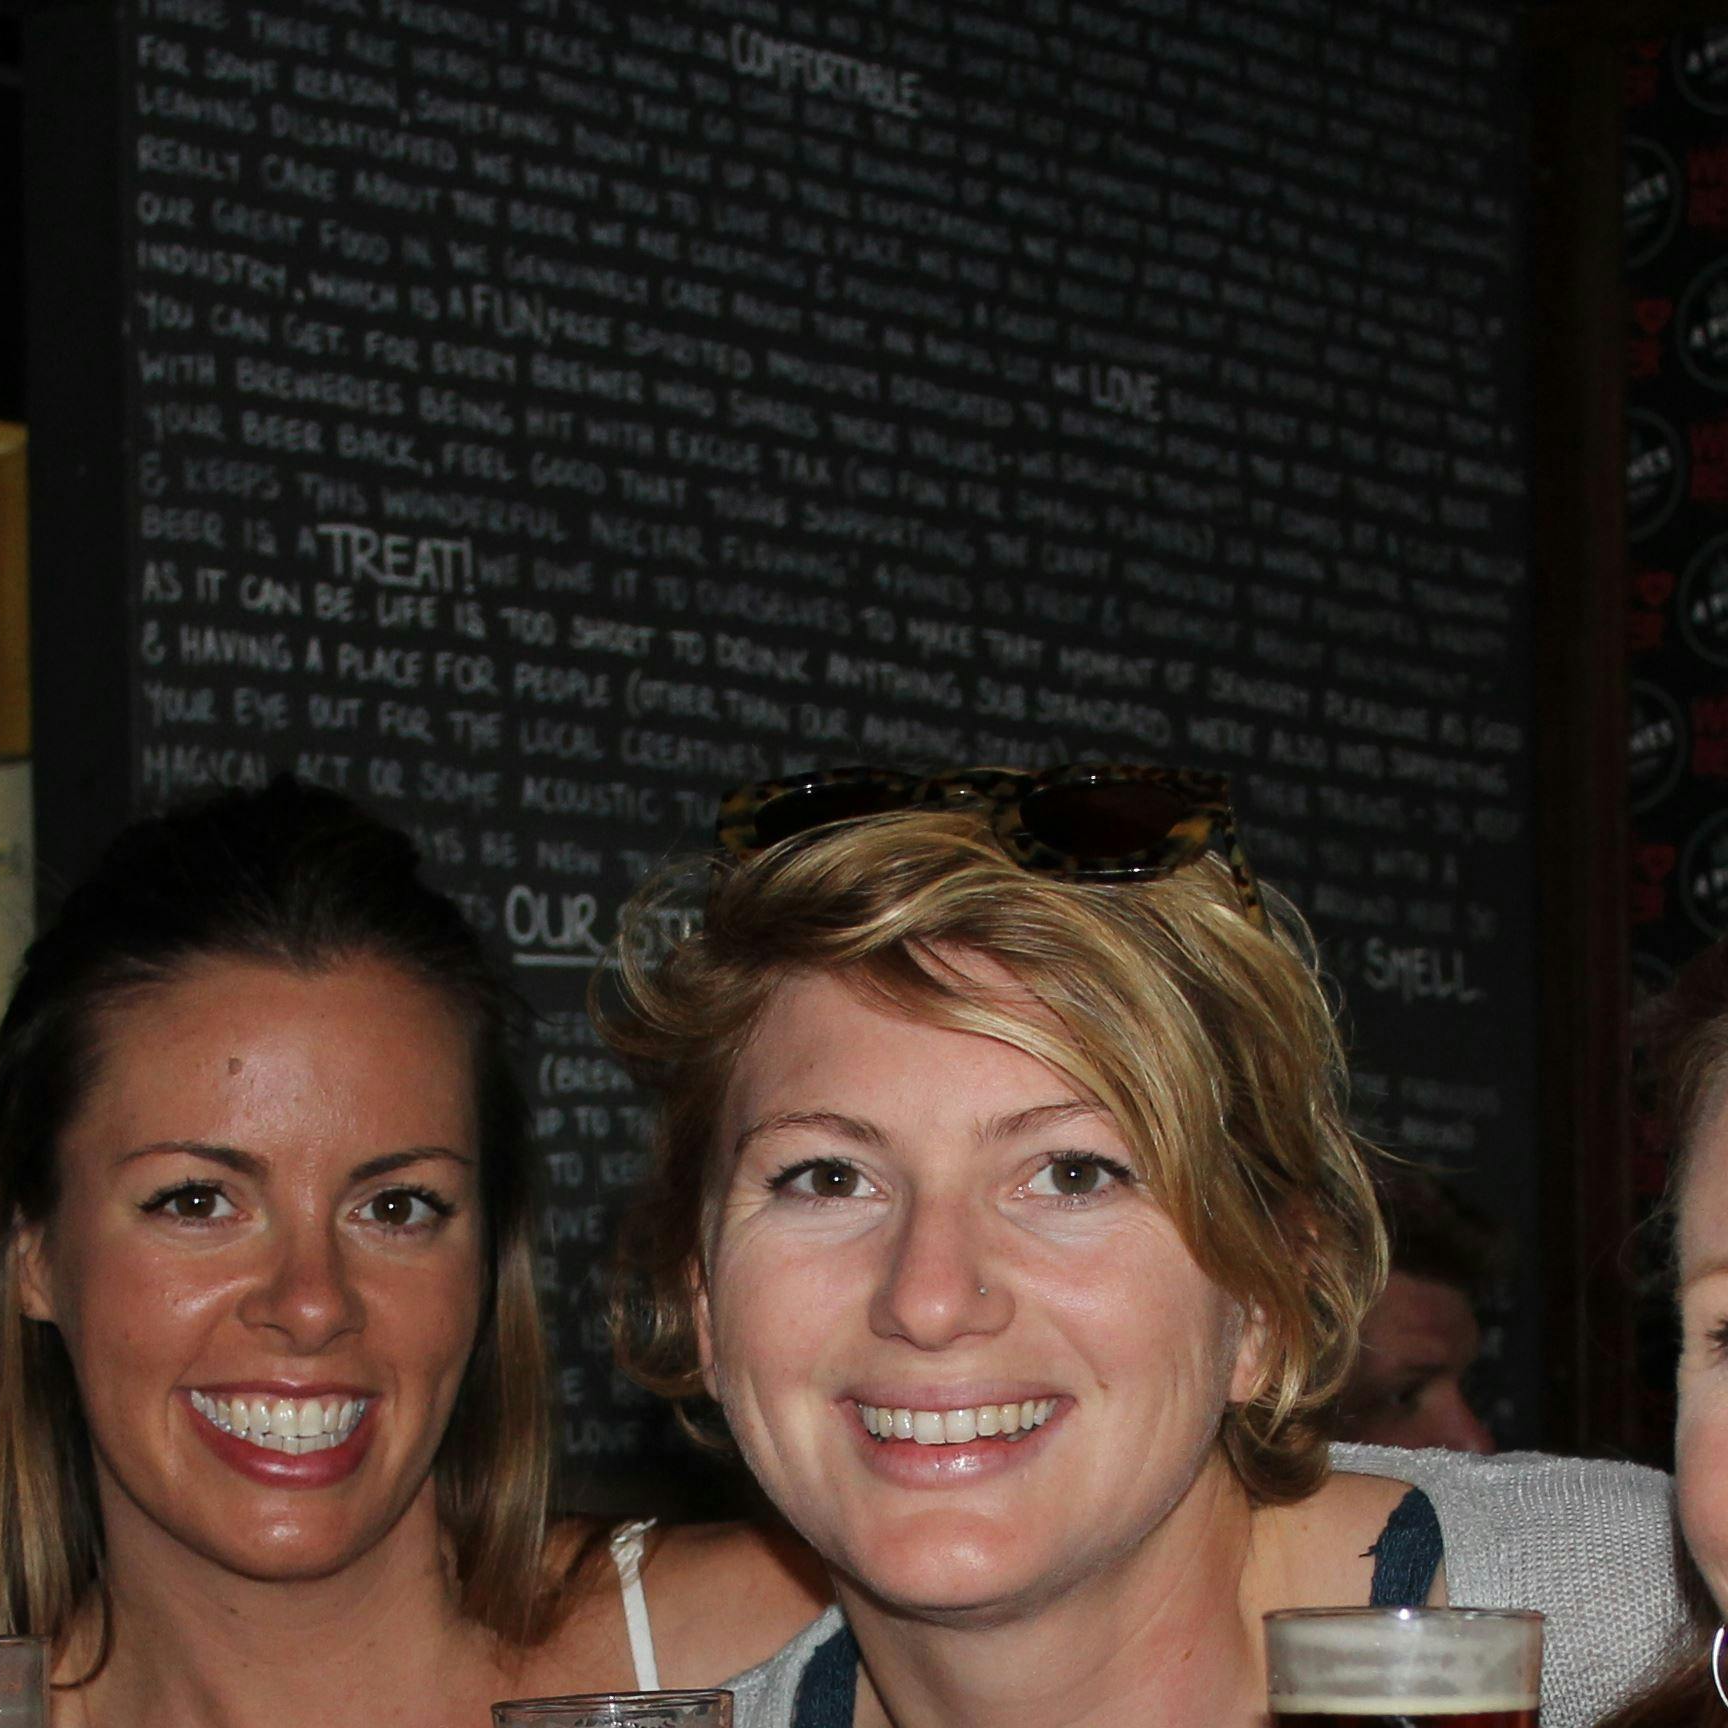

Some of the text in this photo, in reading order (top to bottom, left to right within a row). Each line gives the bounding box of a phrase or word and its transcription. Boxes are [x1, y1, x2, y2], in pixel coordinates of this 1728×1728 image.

[135, 190, 195, 228] OUR
[211, 304, 270, 343] CAN
[136, 348, 217, 386] WITH
[1087, 362, 1164, 423] LOVE
[241, 410, 323, 453] BEER
[315, 521, 476, 595] TREAT!
[141, 559, 184, 604] AS
[195, 567, 228, 603] IT
[239, 574, 303, 615] CAN
[179, 624, 294, 673] HAVING
[337, 643, 422, 688] PLACE
[434, 651, 499, 695] FOR
[504, 883, 608, 955] OUR
